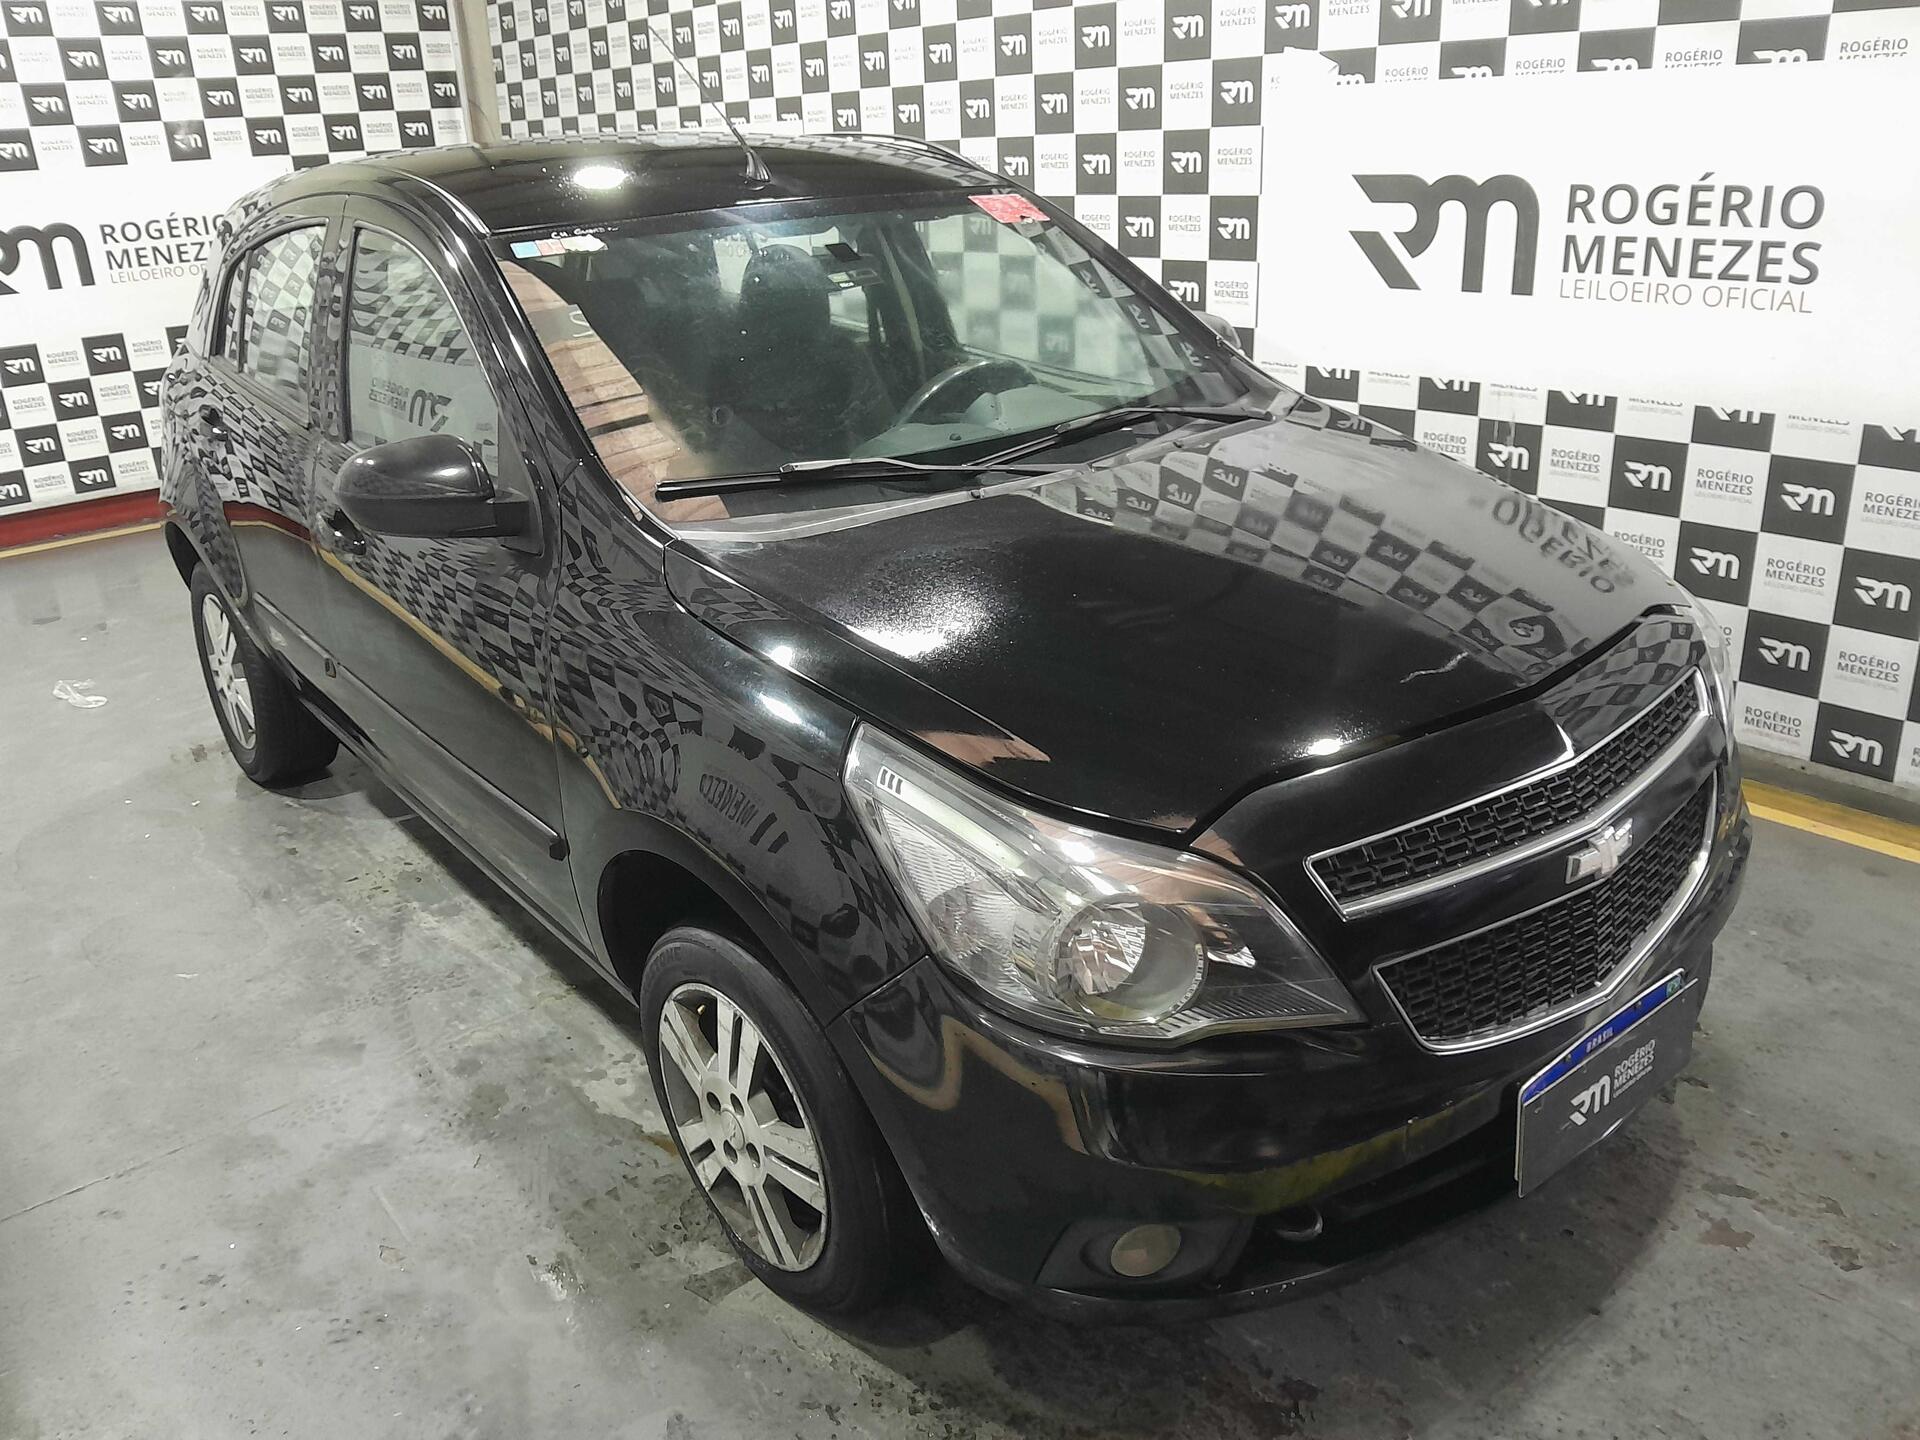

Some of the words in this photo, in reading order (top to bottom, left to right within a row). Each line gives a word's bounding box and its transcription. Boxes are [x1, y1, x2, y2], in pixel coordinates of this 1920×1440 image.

[1839, 37, 1909, 53] ROGÉRIO
[1665, 48, 1723, 62] ROGÉRIO
[1515, 58, 1566, 70] ROGÉRIO
[1567, 172, 1825, 229] ROGÉRIO
[105, 241, 213, 270] MENEZ
[1562, 234, 1822, 285] MENEZES
[110, 266, 184, 283] LEILOEIRO
[1559, 279, 1692, 306] LEILOEIRO
[1702, 285, 1813, 314] OFICIAL
[1423, 431, 1467, 446] ROGÉRIO
[1552, 448, 1600, 463] ROGÉRIO
[1550, 459, 1600, 473] MENEZES
[1698, 468, 1753, 484] ROGÉRIO
[1696, 479, 1752, 495] MENEZES
[1865, 491, 1920, 508] ROGÉRI
[1863, 503, 1920, 520] MENEZE
[1614, 531, 1665, 547] ROGÉRIO
[1767, 558, 1826, 576] ROGÉRIO
[1766, 568, 1824, 587] MENEZES
[1839, 651, 1900, 672] ROGÉRIO
[1837, 662, 1899, 683] MENEZES
[1745, 706, 1801, 727] ROGÉRIO
[1744, 716, 1800, 737] MENEZES
[1586, 1027, 1613, 1053] BRASIL
